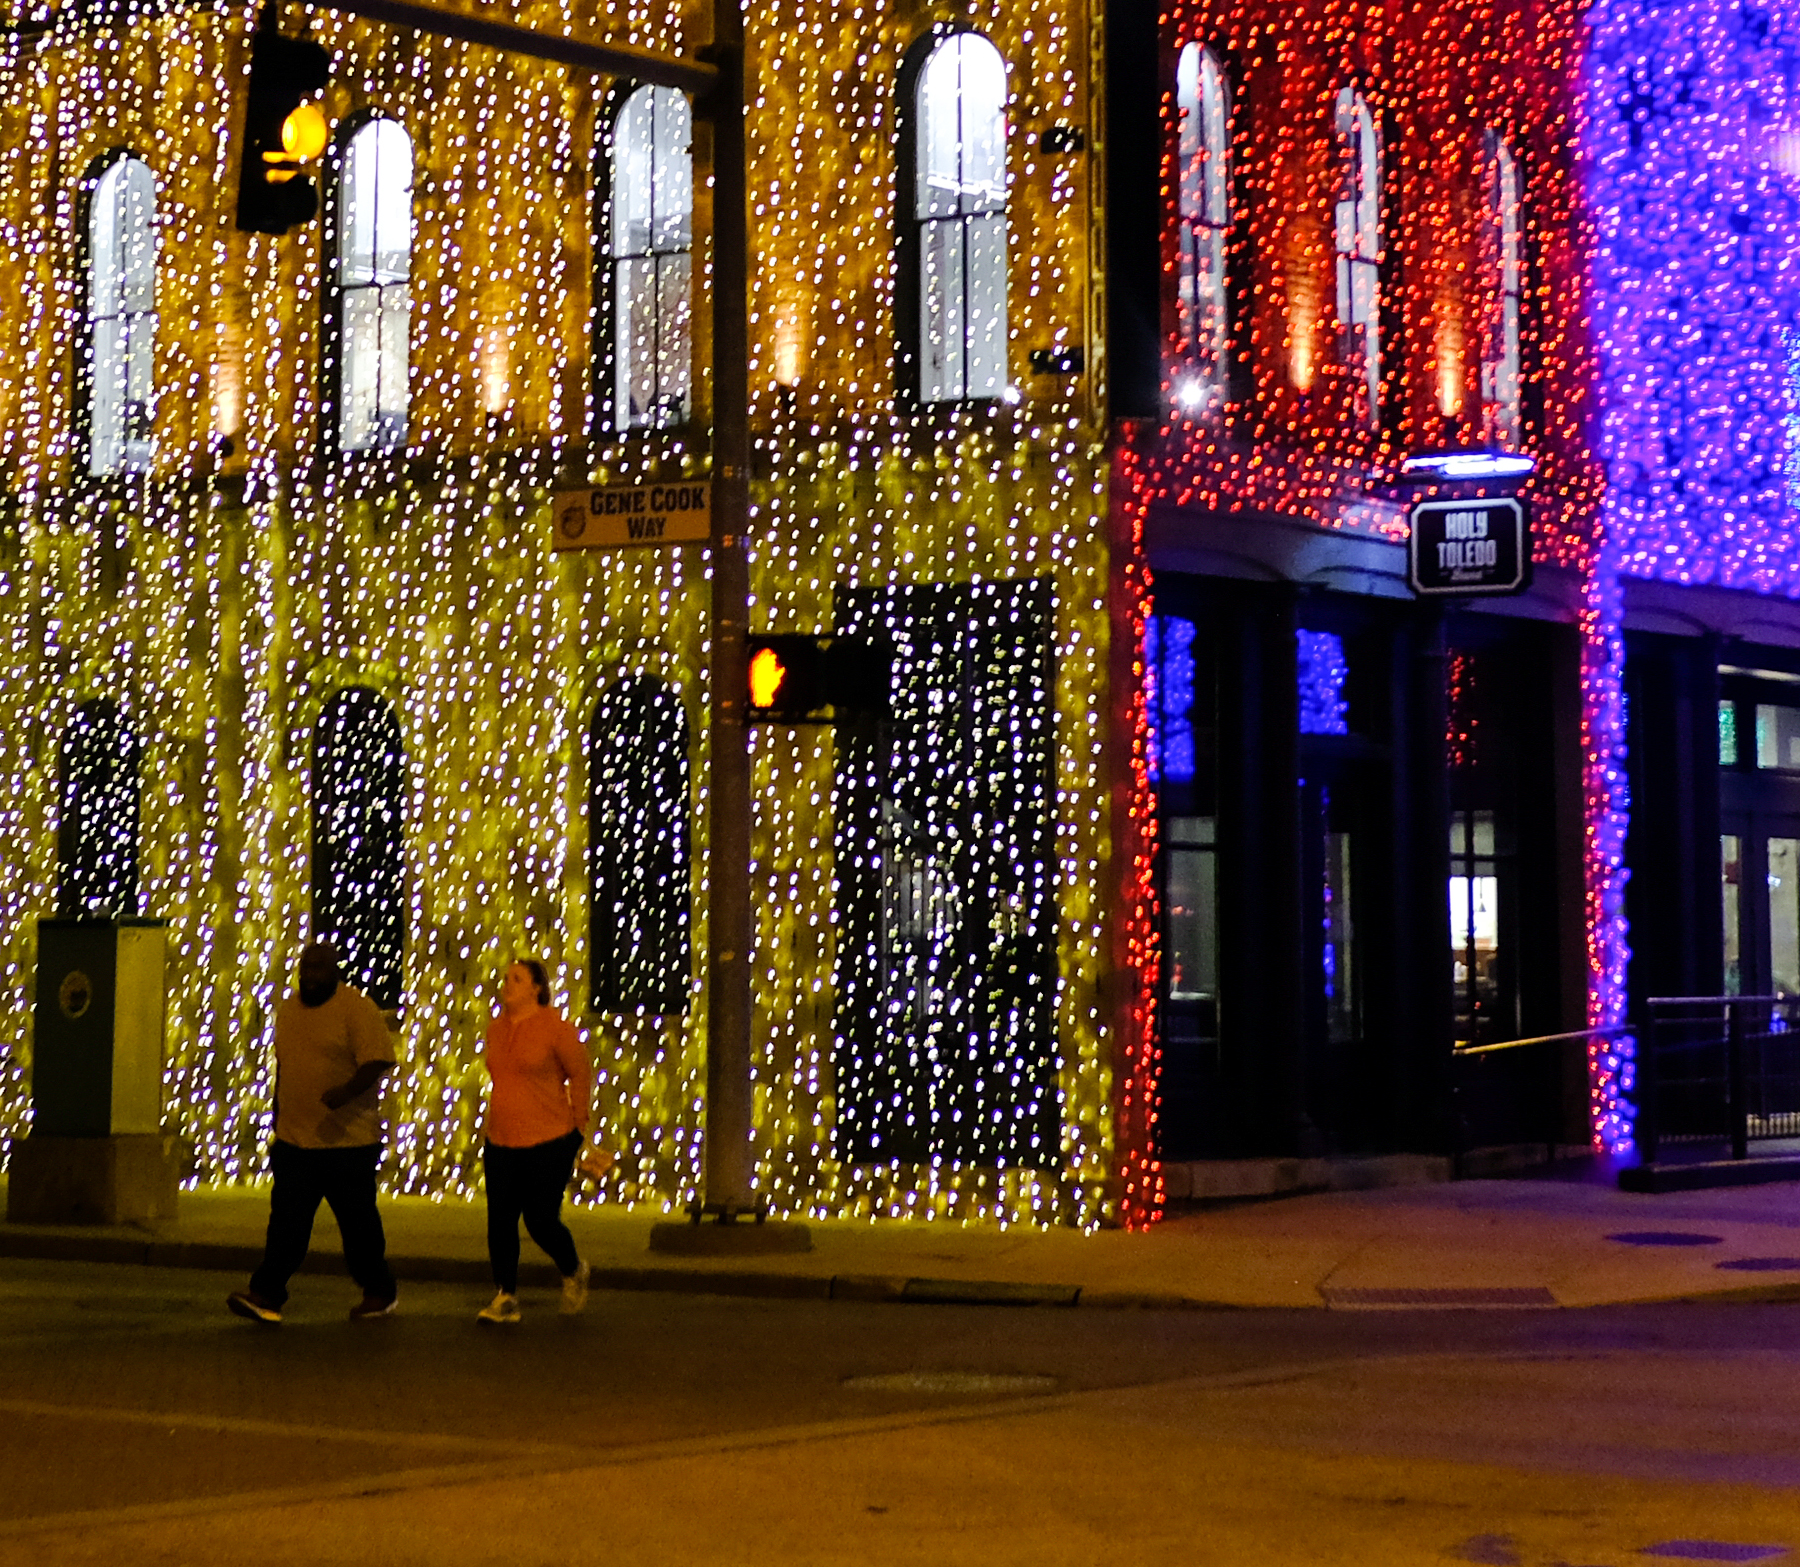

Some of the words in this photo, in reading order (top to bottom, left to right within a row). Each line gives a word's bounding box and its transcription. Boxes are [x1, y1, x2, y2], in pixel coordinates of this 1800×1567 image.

[590, 489, 645, 515] GENE
[650, 486, 705, 512] COOK
[627, 516, 667, 538] WAY
[1445, 510, 1488, 539] HOLY
[1436, 539, 1497, 568] TOLEDO
